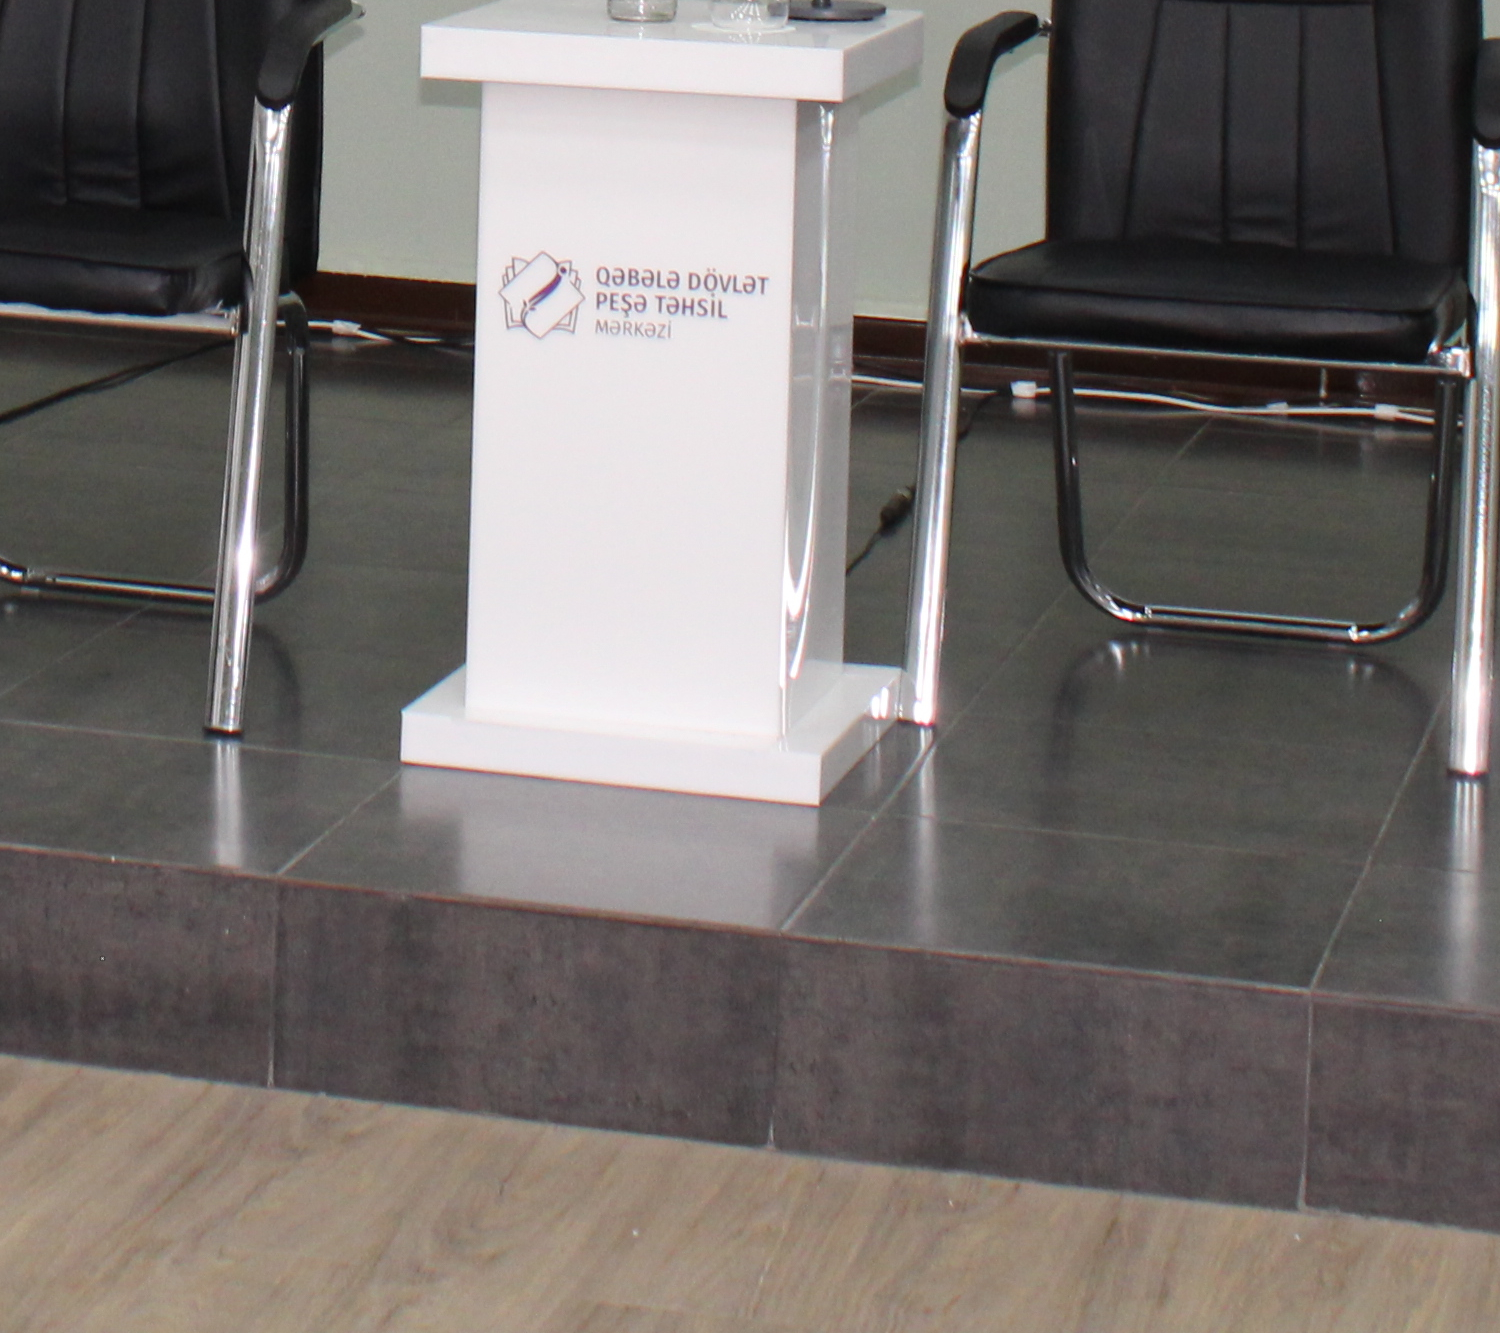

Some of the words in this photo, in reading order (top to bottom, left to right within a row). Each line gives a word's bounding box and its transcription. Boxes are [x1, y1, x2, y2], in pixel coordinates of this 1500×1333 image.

[595, 265, 681, 290] QƏBƏLƏ
[687, 267, 770, 295] DÖVLƏT
[595, 291, 648, 319] PEŞƏ
[654, 293, 729, 319] TƏHSİL
[594, 319, 672, 339] MƏRKƏZİ
